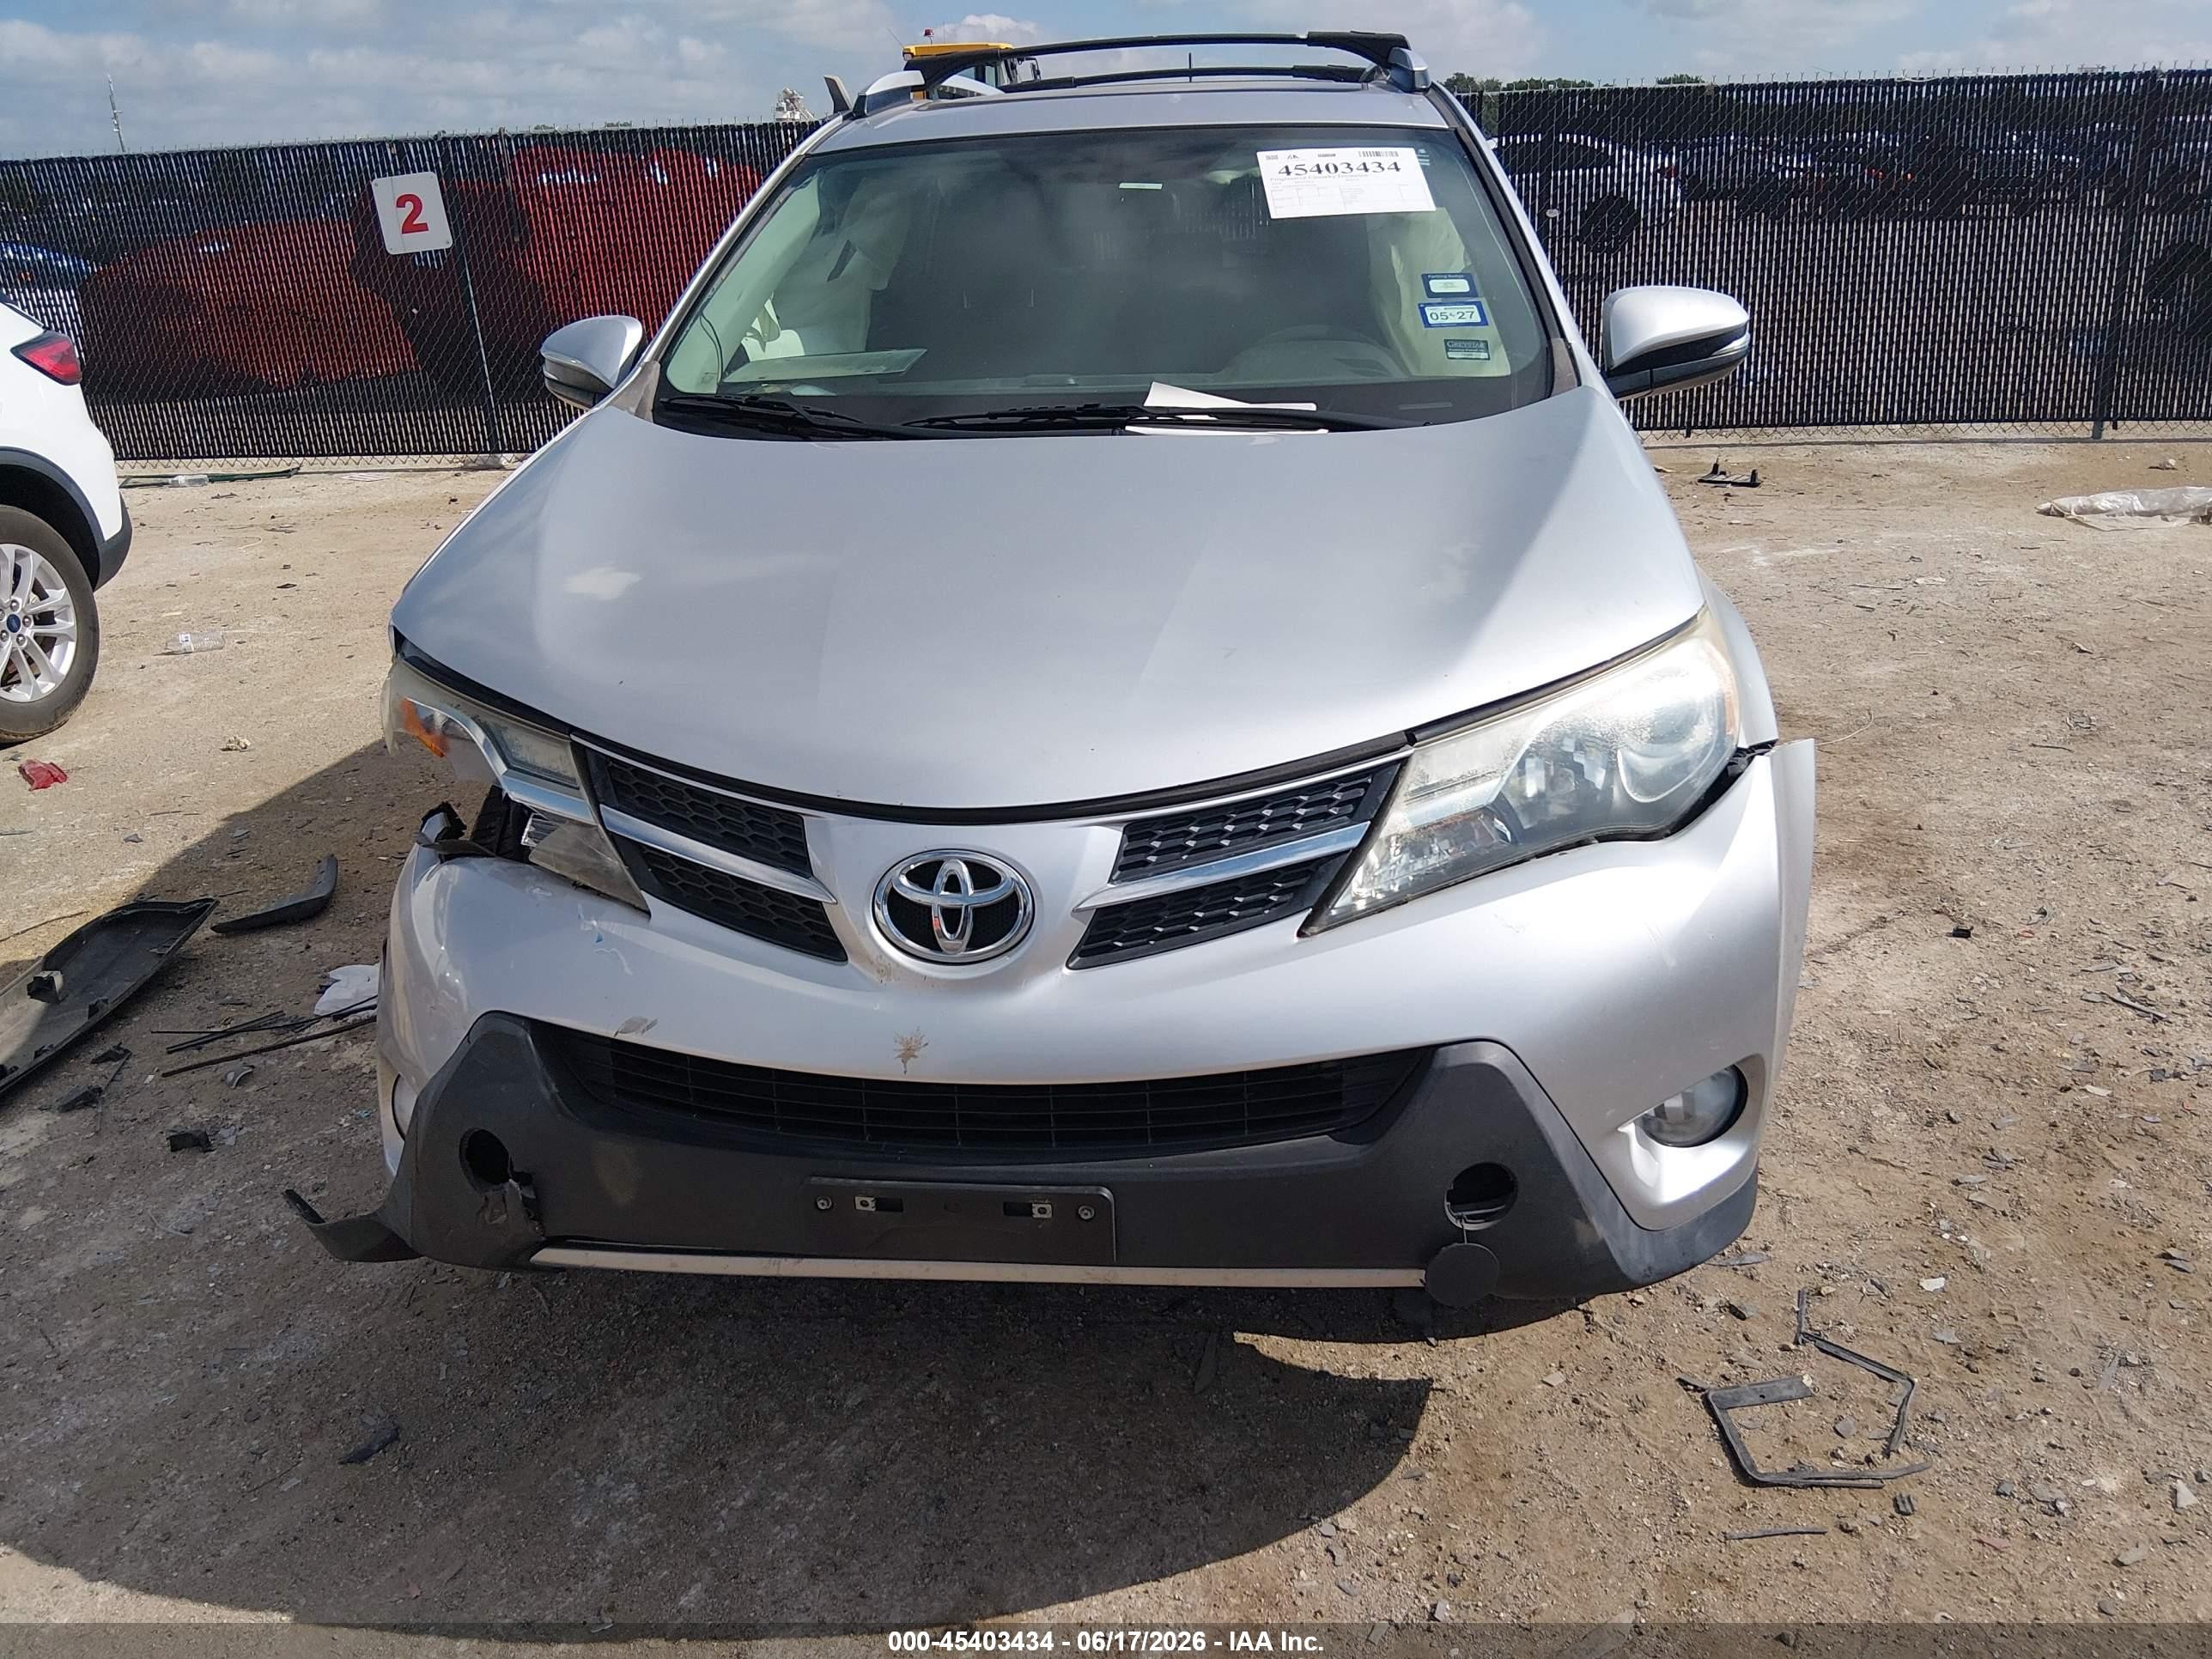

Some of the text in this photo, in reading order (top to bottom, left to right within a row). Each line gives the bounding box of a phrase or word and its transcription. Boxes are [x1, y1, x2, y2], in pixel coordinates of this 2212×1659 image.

[1278, 161, 1401, 176] 45403434
[396, 193, 429, 234] 2
[1429, 311, 1475, 321] 05 27
